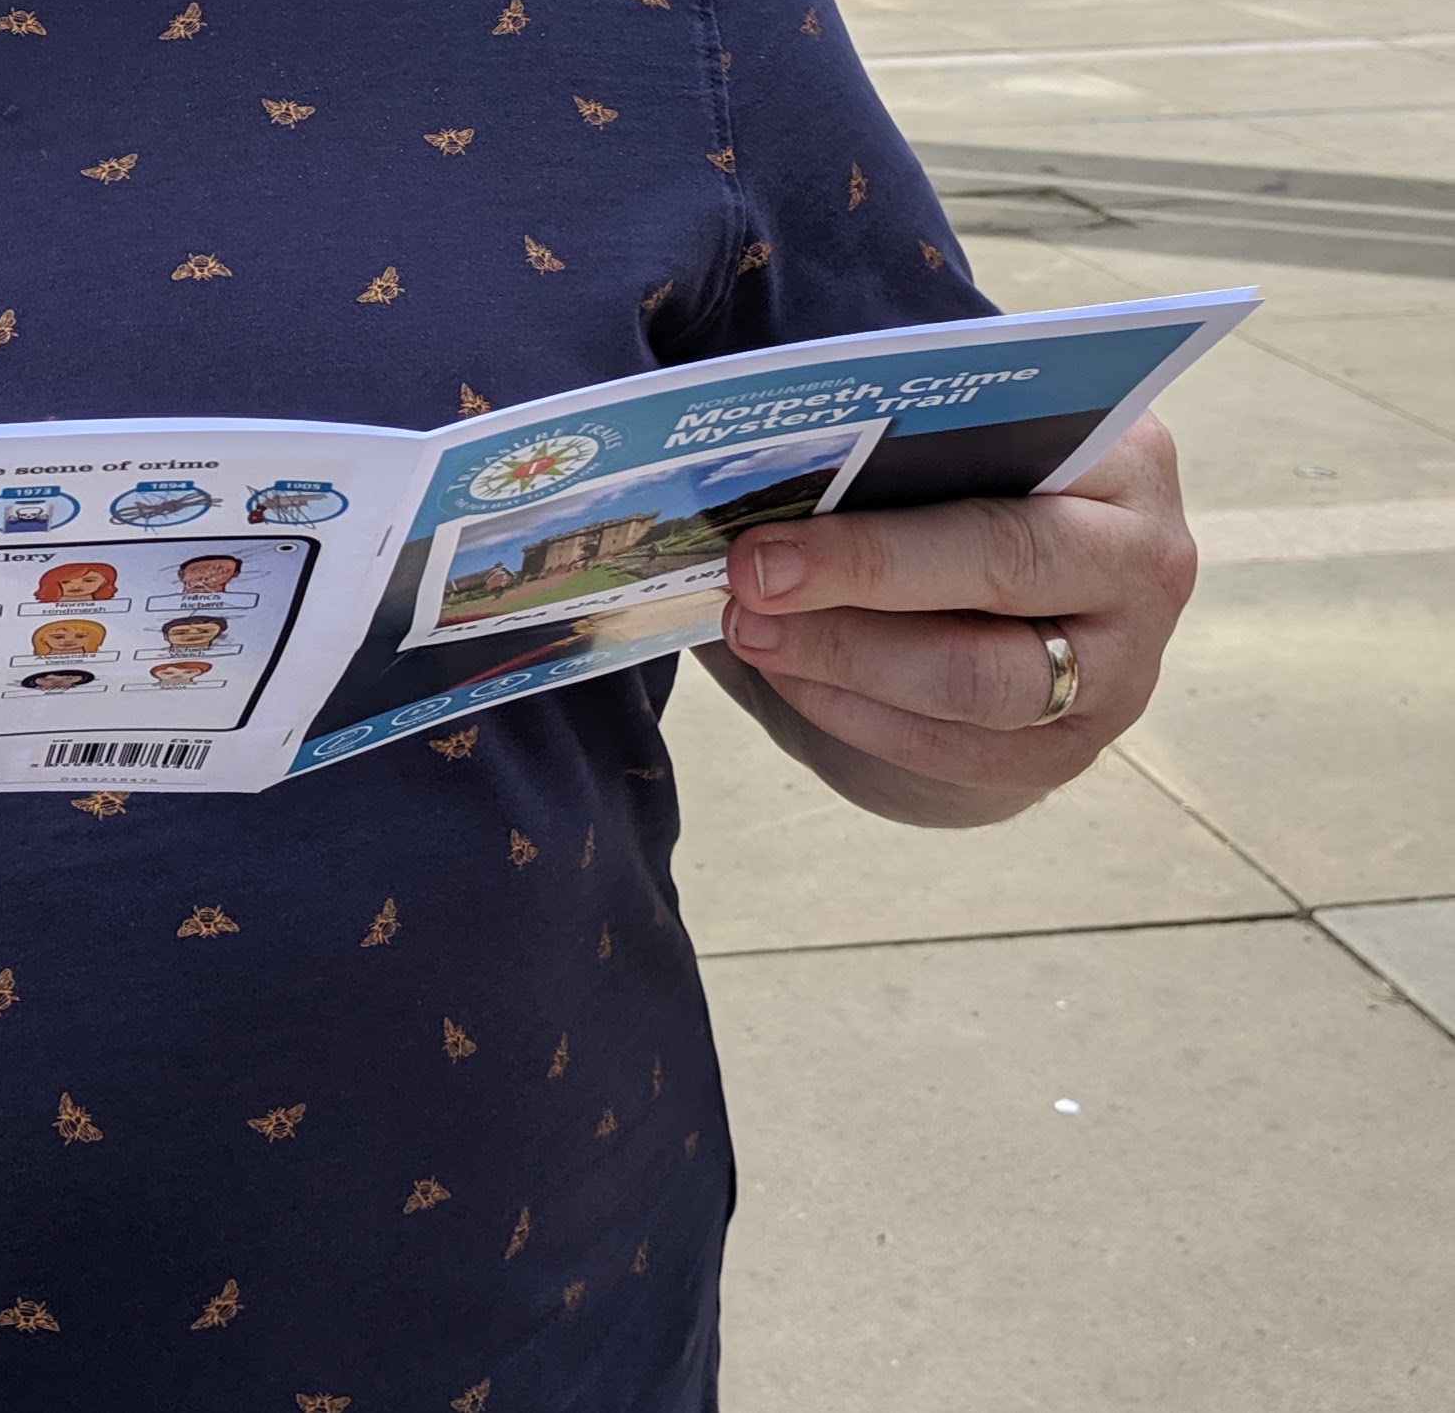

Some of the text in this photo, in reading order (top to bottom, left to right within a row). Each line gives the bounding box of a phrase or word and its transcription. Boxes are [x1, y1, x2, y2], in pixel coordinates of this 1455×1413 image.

[674, 367, 1040, 431] Morpeth Crime
[687, 376, 856, 412] NORTHUMBRIA
[663, 387, 980, 450] Mystery Trail
[577, 422, 622, 450] TRAILS
[14, 462, 93, 475] scene
[102, 460, 129, 472] of
[138, 458, 220, 471] crime
[14, 487, 53, 496] 1973
[564, 593, 624, 610] way
